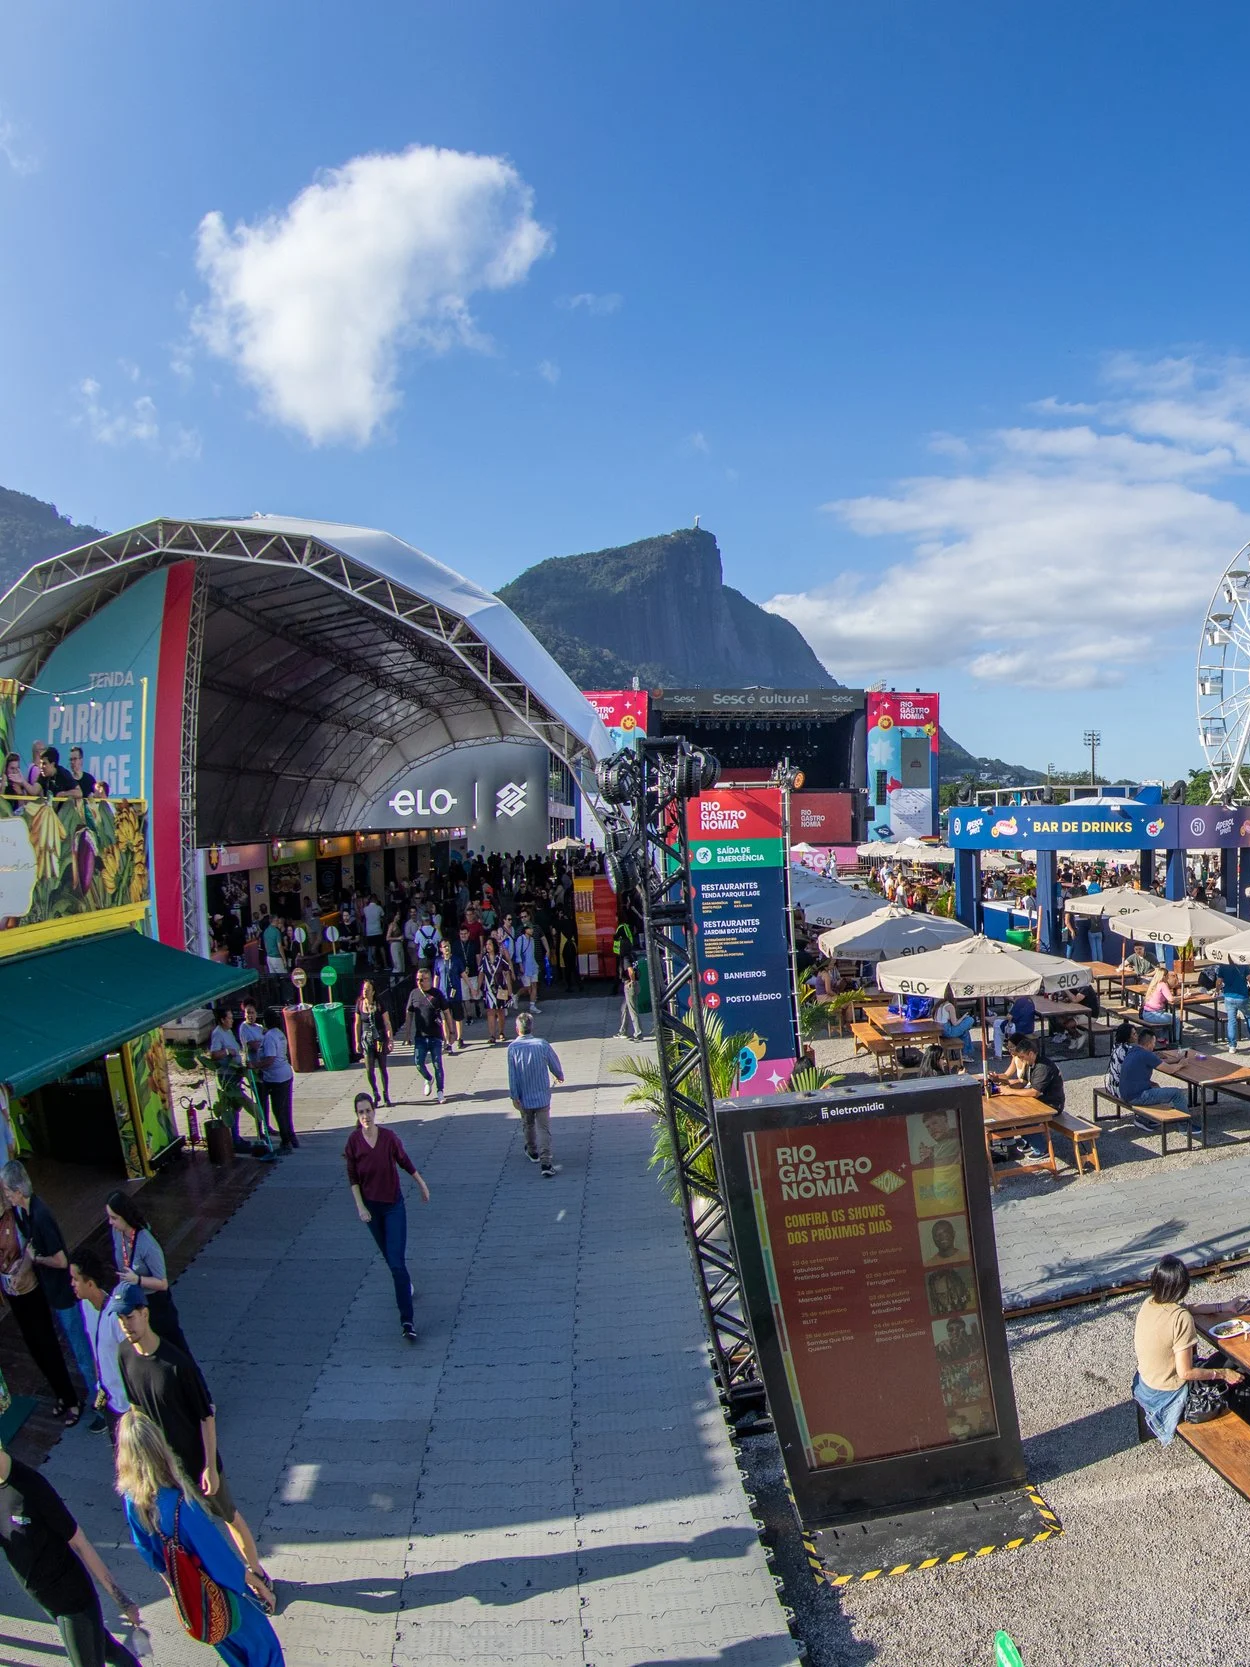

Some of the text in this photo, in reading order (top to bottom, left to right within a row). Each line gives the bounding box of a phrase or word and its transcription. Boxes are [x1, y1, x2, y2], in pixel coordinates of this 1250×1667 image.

[89, 671, 134, 688] TENDA
[712, 694, 746, 704] Sesc
[760, 694, 808, 704] cultura!
[48, 700, 134, 744] PARQUE
[88, 754, 130, 795] AGE
[701, 802, 720, 812] RIO
[701, 810, 746, 820] GASTRO
[702, 820, 739, 830] NOMIA
[1034, 822, 1132, 832] BAR DE DRINKS
[1216, 818, 1234, 831] APEROL
[717, 846, 740, 854] SAÍDA
[717, 854, 764, 862] EMERGÊNCIA
[702, 882, 758, 892] RESTAURANTES
[703, 918, 760, 928] RESTAURANTES
[724, 970, 766, 980] BANHEIROS
[979, 984, 1030, 994] ESTILO
[726, 992, 782, 1004] POSTO MÉDICO
[830, 1102, 884, 1116] eletromidia
[776, 1144, 816, 1166] RIO
[778, 1156, 872, 1184] GASTRO
[782, 1176, 860, 1200] NOMIA
[785, 1204, 886, 1229] CONFIRA OS SHOWS
[787, 1219, 893, 1246] DOS PRÓXIMOS DIAS
[810, 1256, 838, 1264] setembro
[793, 1266, 824, 1274] Fabulosos
[866, 1278, 896, 1286] Ferrugem
[815, 1286, 844, 1294] setembro
[818, 1307, 848, 1316] setembro
[806, 1339, 828, 1347] Samba
